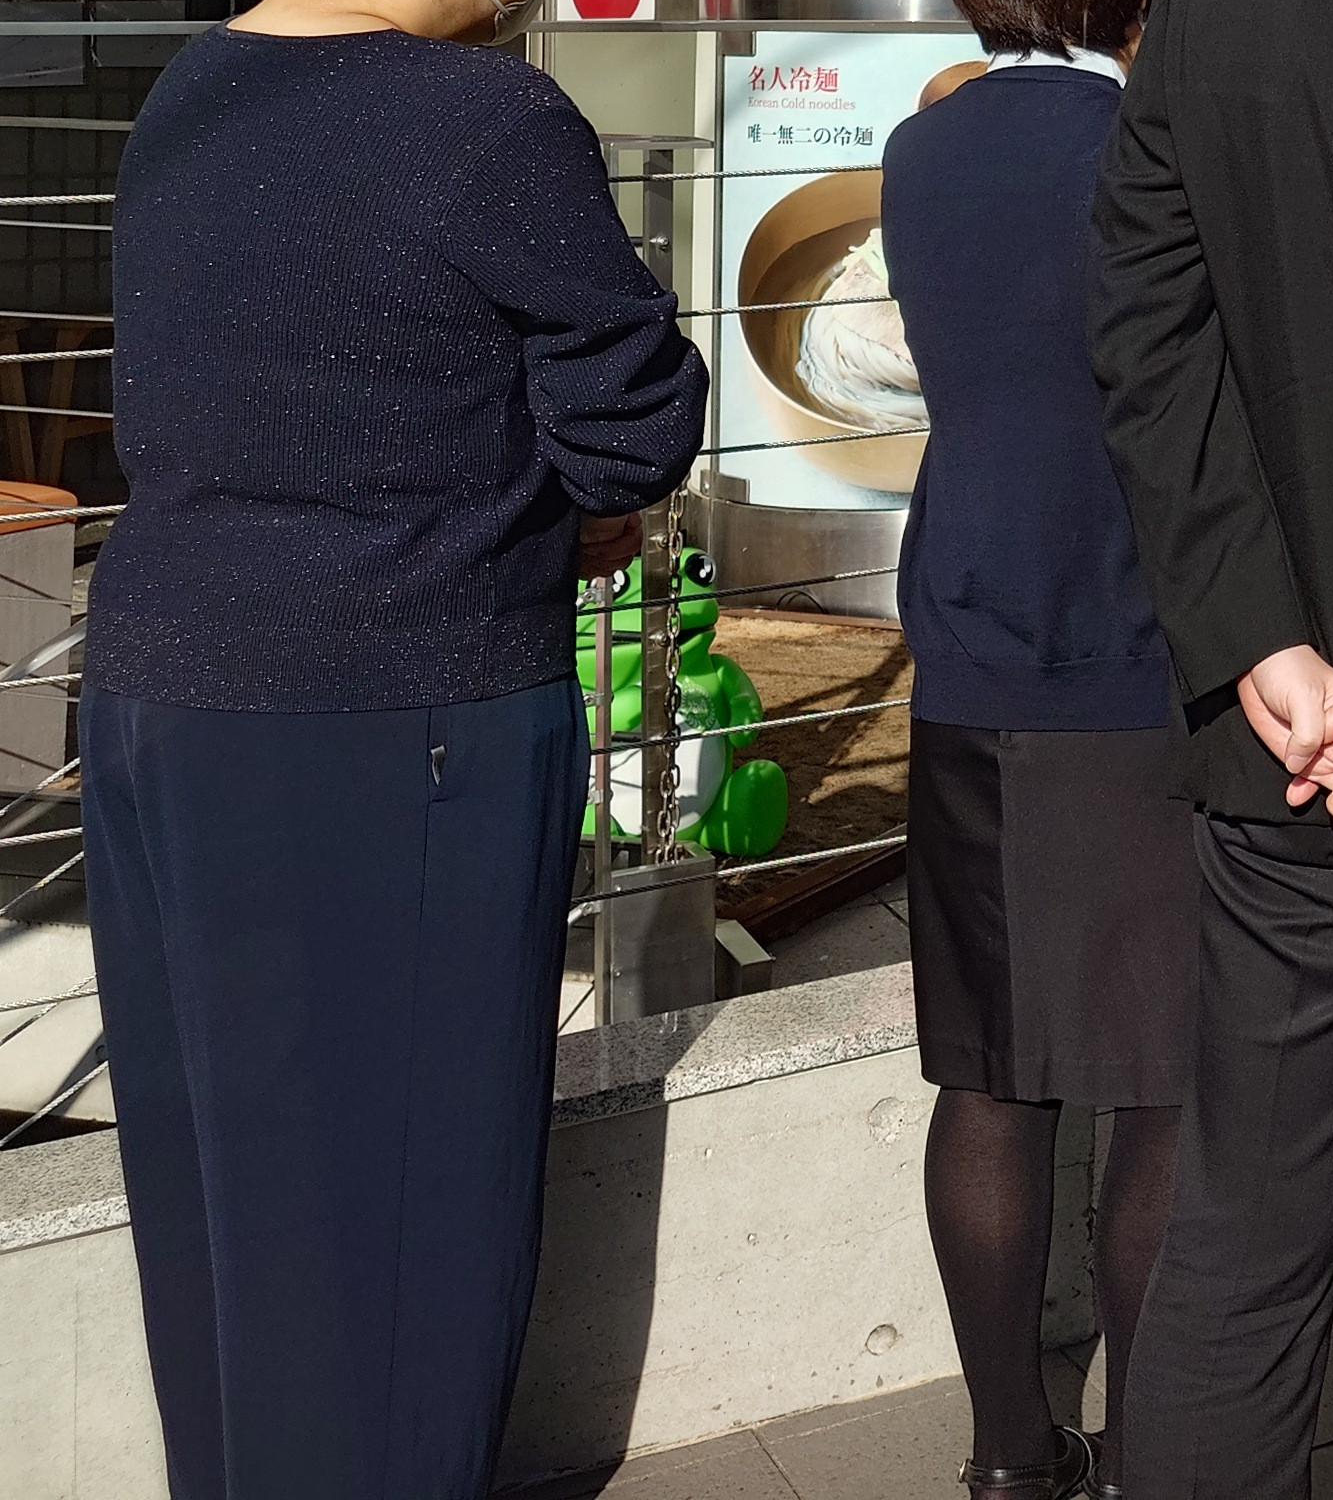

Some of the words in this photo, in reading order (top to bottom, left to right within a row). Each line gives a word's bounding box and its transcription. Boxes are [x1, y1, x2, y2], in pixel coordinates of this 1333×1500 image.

[748, 65, 839, 93] 名人冷麺
[748, 97, 779, 108] Korean
[781, 98, 805, 109] Cold
[809, 98, 856, 111] noodles
[747, 123, 874, 146] 唯一無二の冷麺
